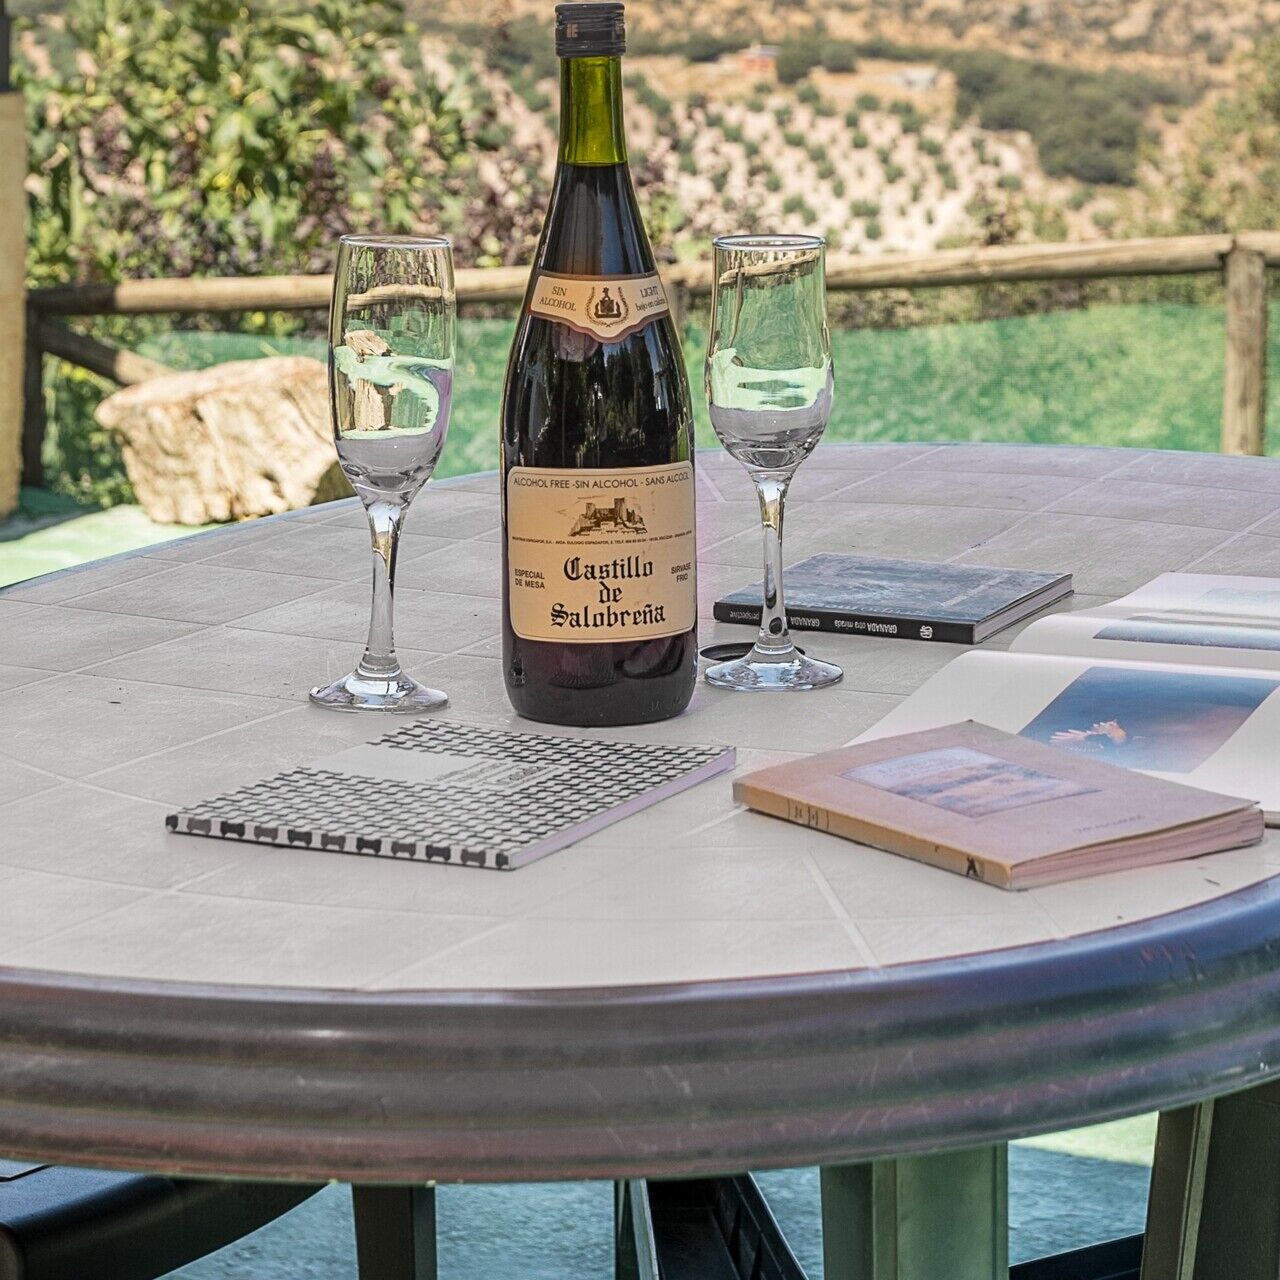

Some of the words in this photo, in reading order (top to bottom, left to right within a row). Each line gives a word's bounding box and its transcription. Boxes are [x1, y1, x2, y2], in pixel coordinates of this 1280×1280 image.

[551, 285, 568, 297] SIN
[640, 285, 659, 298] LIGHT
[539, 296, 577, 312] ALCOHOL
[514, 477, 549, 489] ALCOHOL
[550, 479, 570, 489] FREE
[592, 479, 638, 489] ALCOHOL
[645, 475, 665, 486] SANS
[666, 471, 690, 484] ALCOOL
[514, 568, 545, 580] ESPECIAL
[563, 555, 653, 581] Castillo
[671, 562, 692, 575] SIRVASE
[515, 578, 523, 587] DE
[524, 580, 545, 590] MESA
[676, 573, 689, 583] FRIO
[598, 581, 623, 604] de
[550, 602, 666, 629] Salobreña
[729, 610, 760, 621] perspective
[790, 616, 821, 628] GRANADA
[834, 619, 854, 630] mirada
[866, 621, 898, 635] GRANADA
